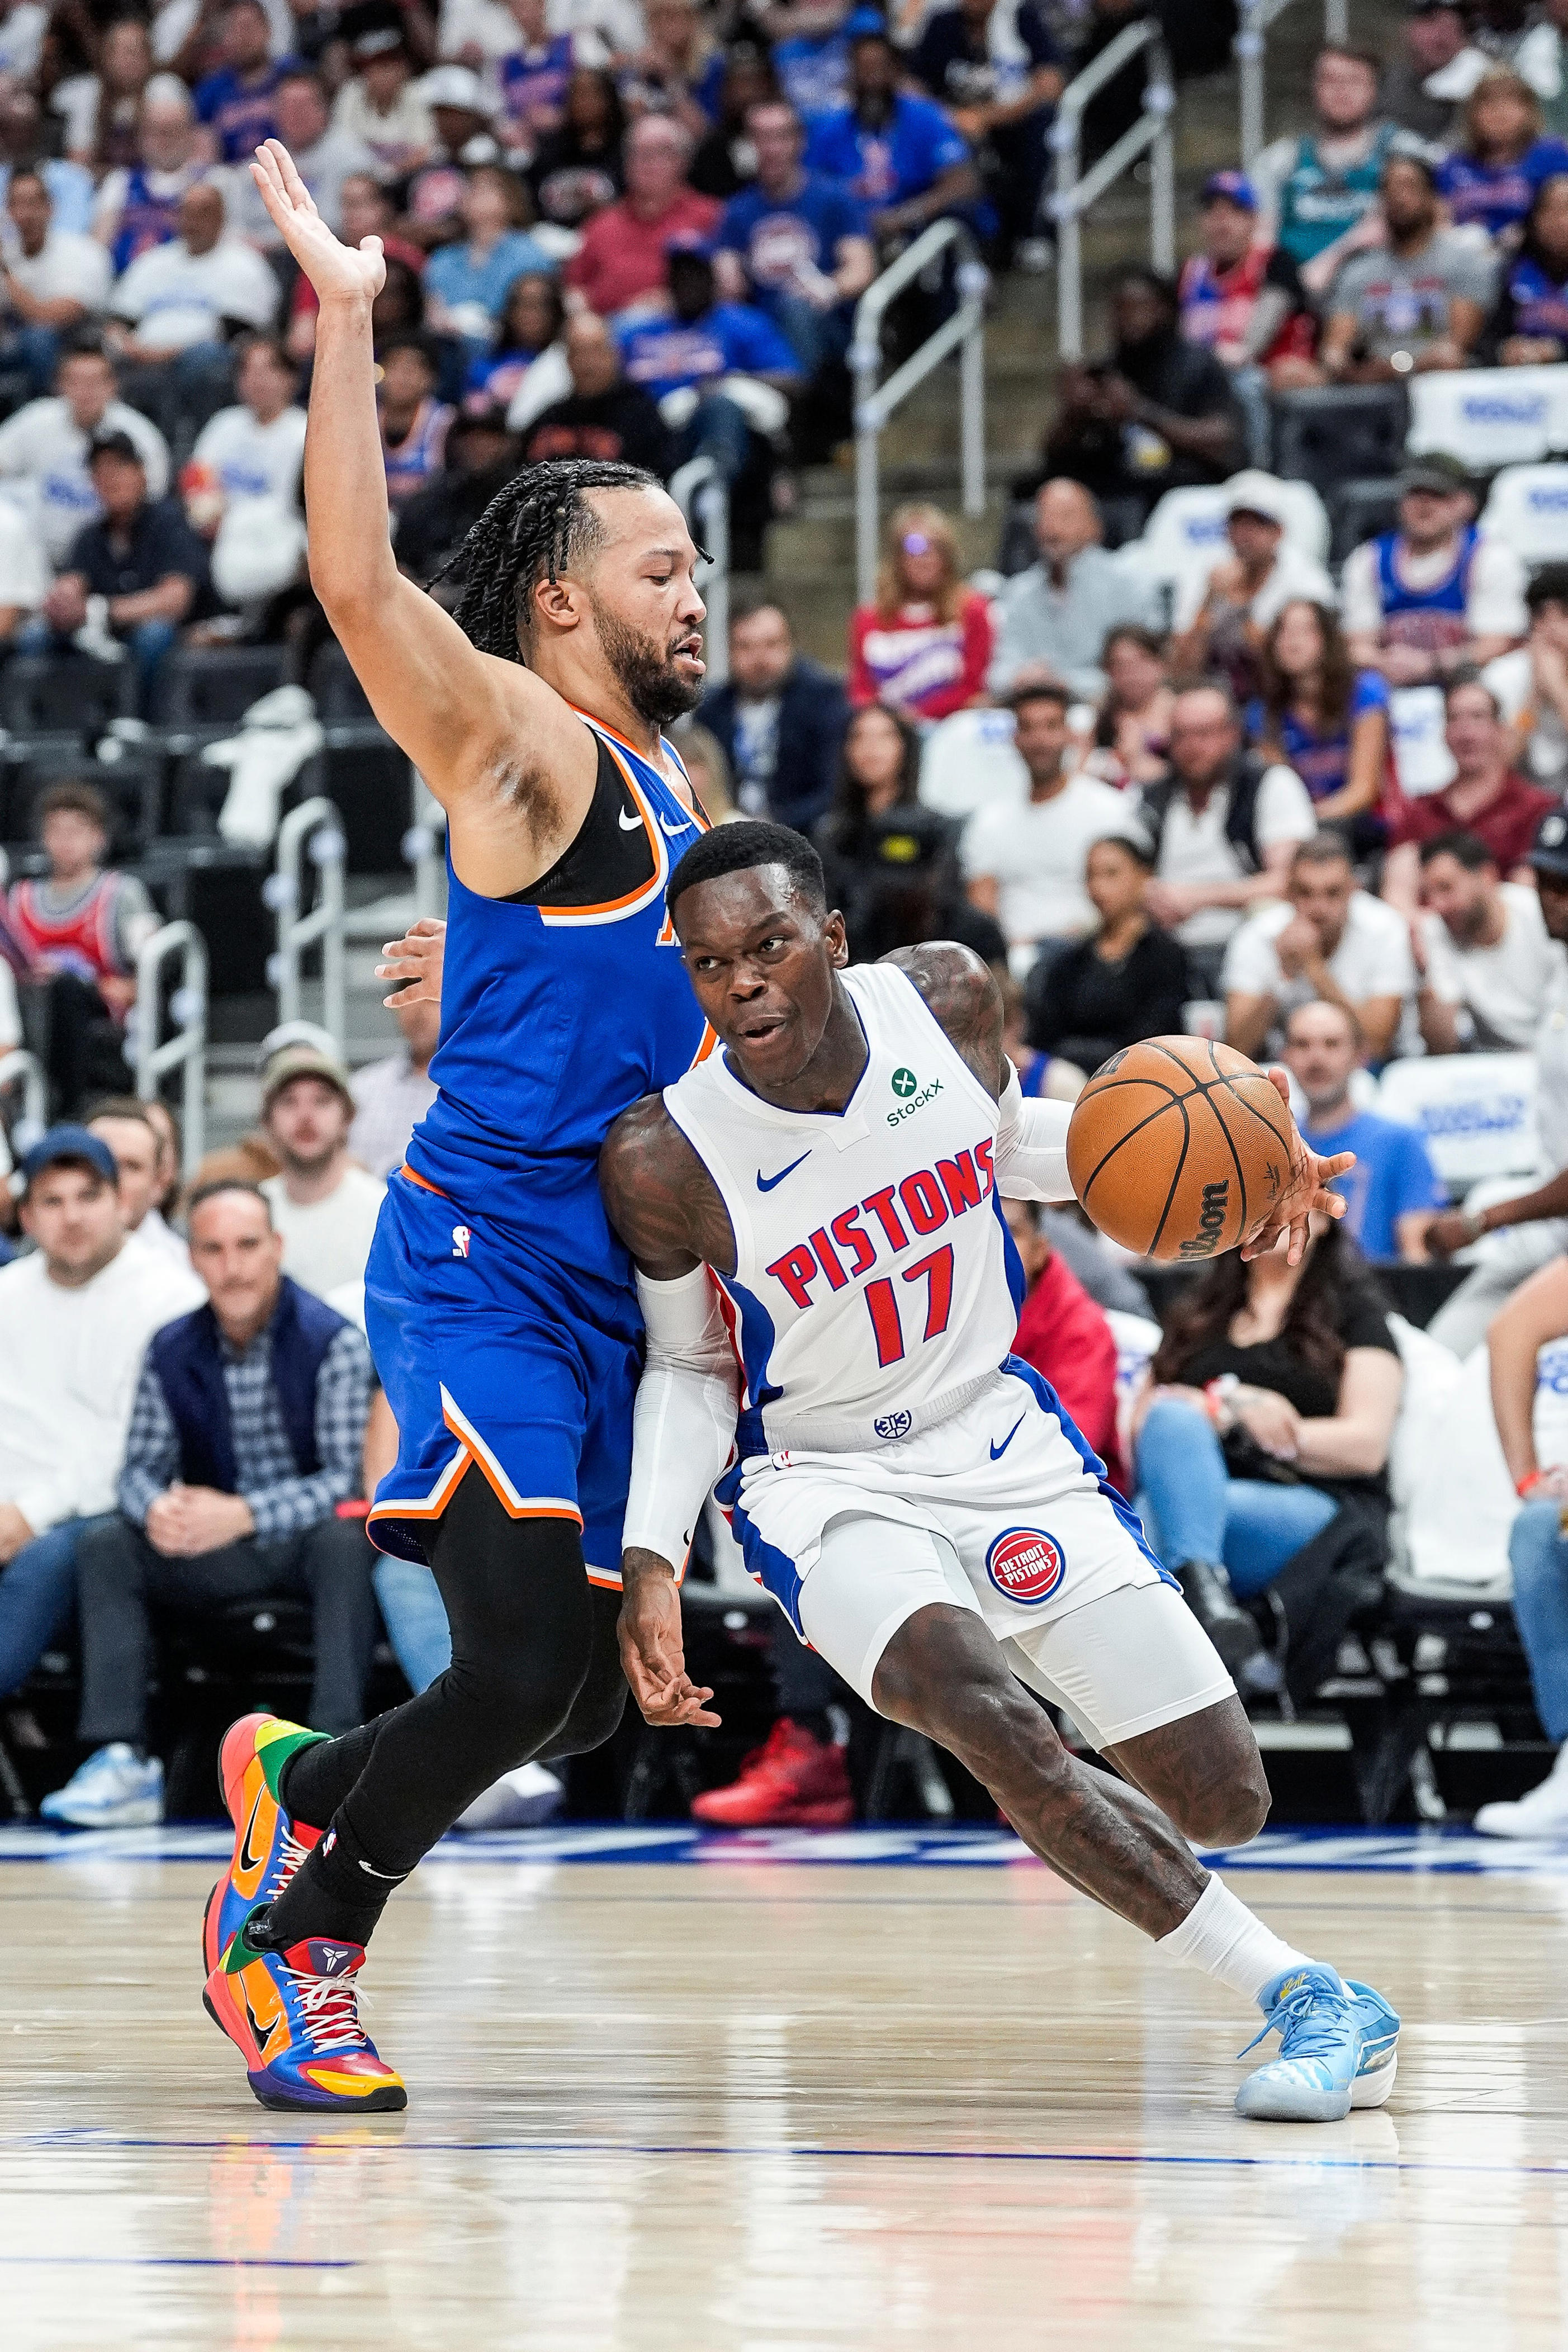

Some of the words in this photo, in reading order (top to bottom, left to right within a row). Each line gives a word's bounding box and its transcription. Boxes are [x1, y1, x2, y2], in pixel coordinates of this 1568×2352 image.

[887, 1078, 944, 1127] StockX
[765, 1136, 994, 1309] PISTONS
[863, 1242, 954, 1369] 17
[998, 1543, 1045, 1574] DETROIT
[1004, 1555, 1053, 1586] PISTONS
